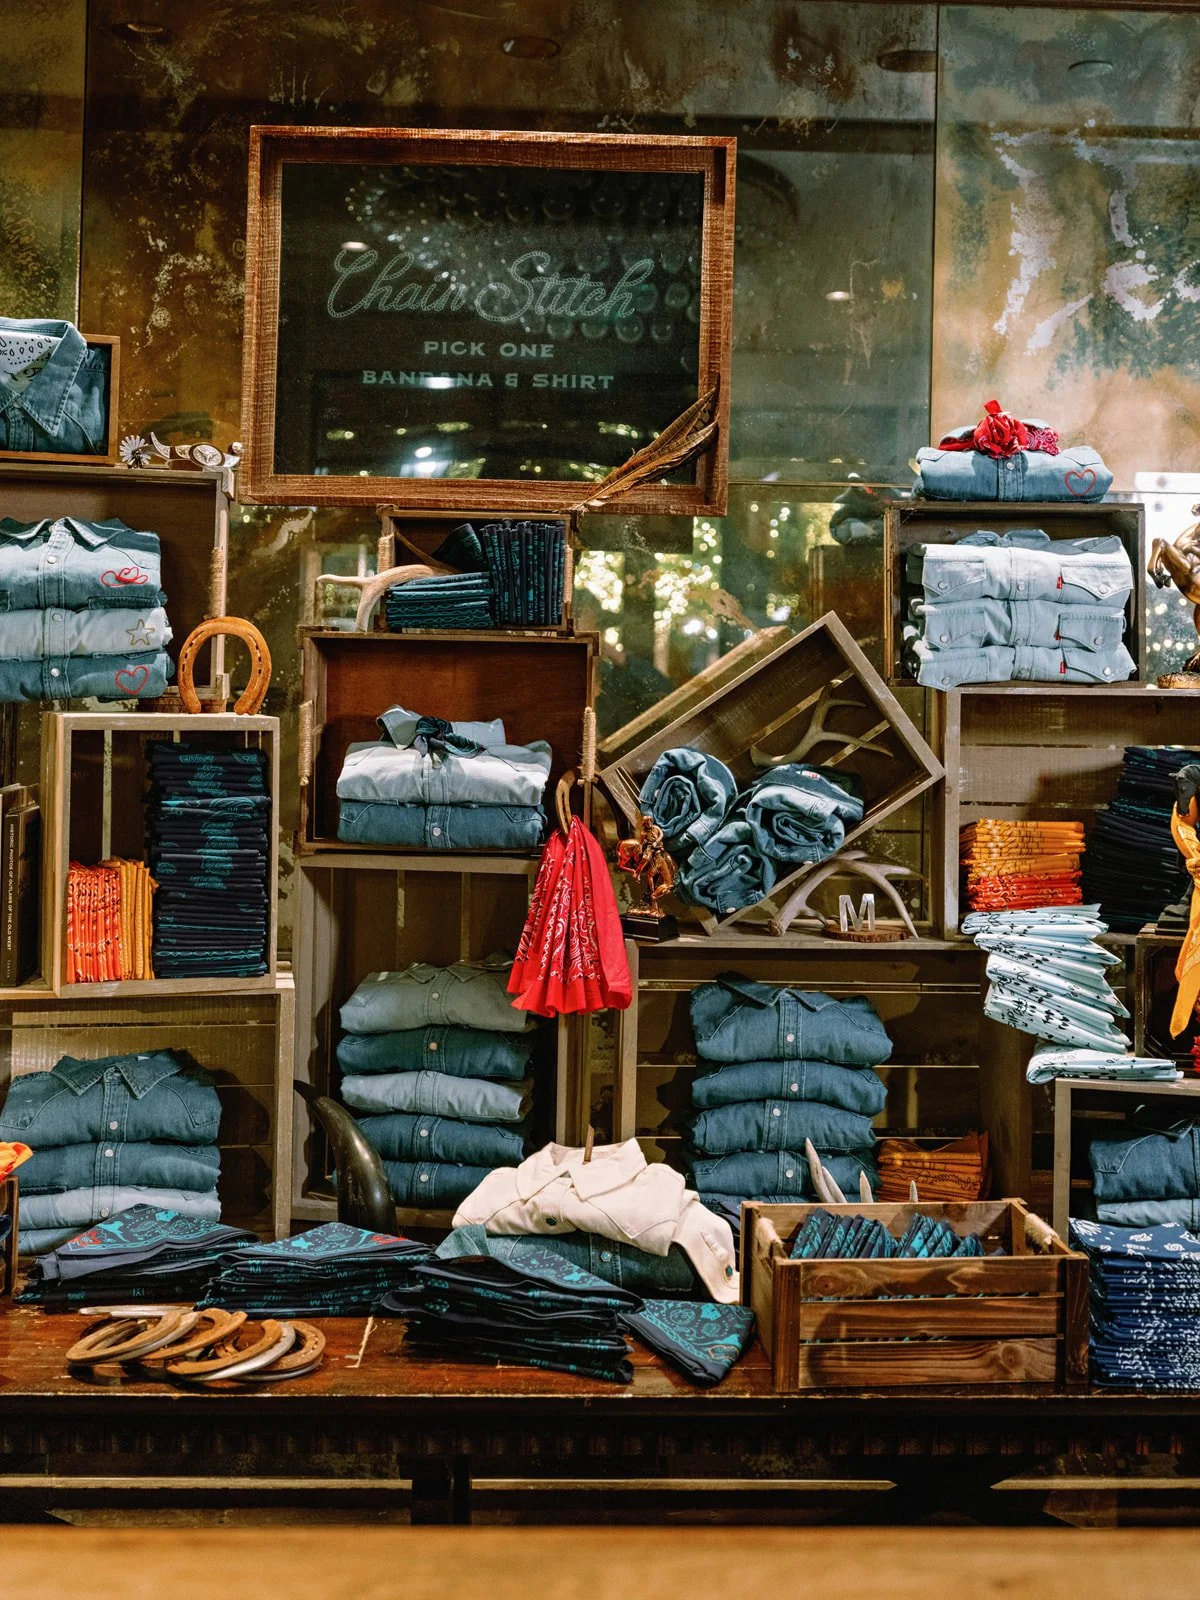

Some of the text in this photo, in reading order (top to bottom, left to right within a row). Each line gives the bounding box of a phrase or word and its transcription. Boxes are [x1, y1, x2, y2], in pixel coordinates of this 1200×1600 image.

[327, 250, 655, 322] Chain Stitch
[424, 341, 555, 358] PICK ONE
[505, 373, 519, 387] &
[532, 373, 615, 390] SHIRT
[838, 893, 876, 932] M
